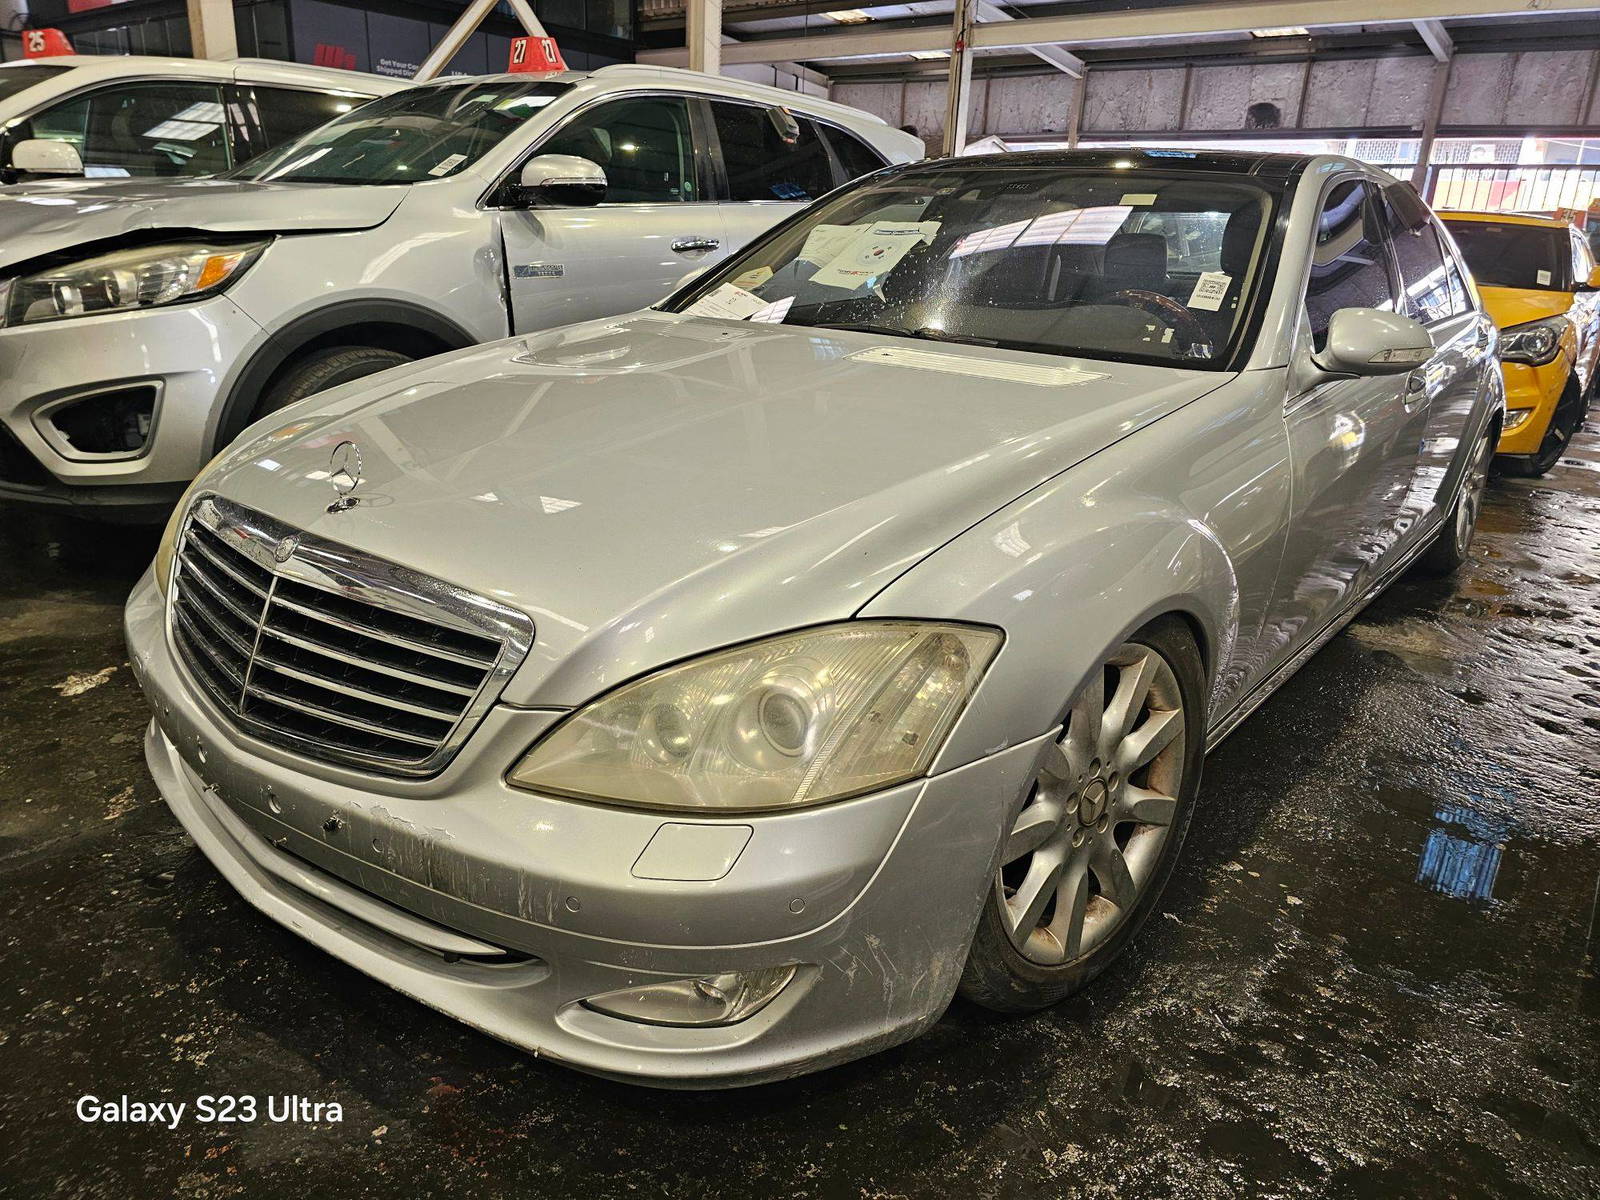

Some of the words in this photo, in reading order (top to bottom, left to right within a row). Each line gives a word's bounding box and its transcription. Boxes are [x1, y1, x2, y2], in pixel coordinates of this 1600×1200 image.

[28, 31, 45, 52] 25
[513, 39, 527, 64] 27
[541, 39, 557, 63] 27
[376, 65, 402, 75] Shipped
[380, 58, 391, 66] Get
[391, 60, 407, 69] Your
